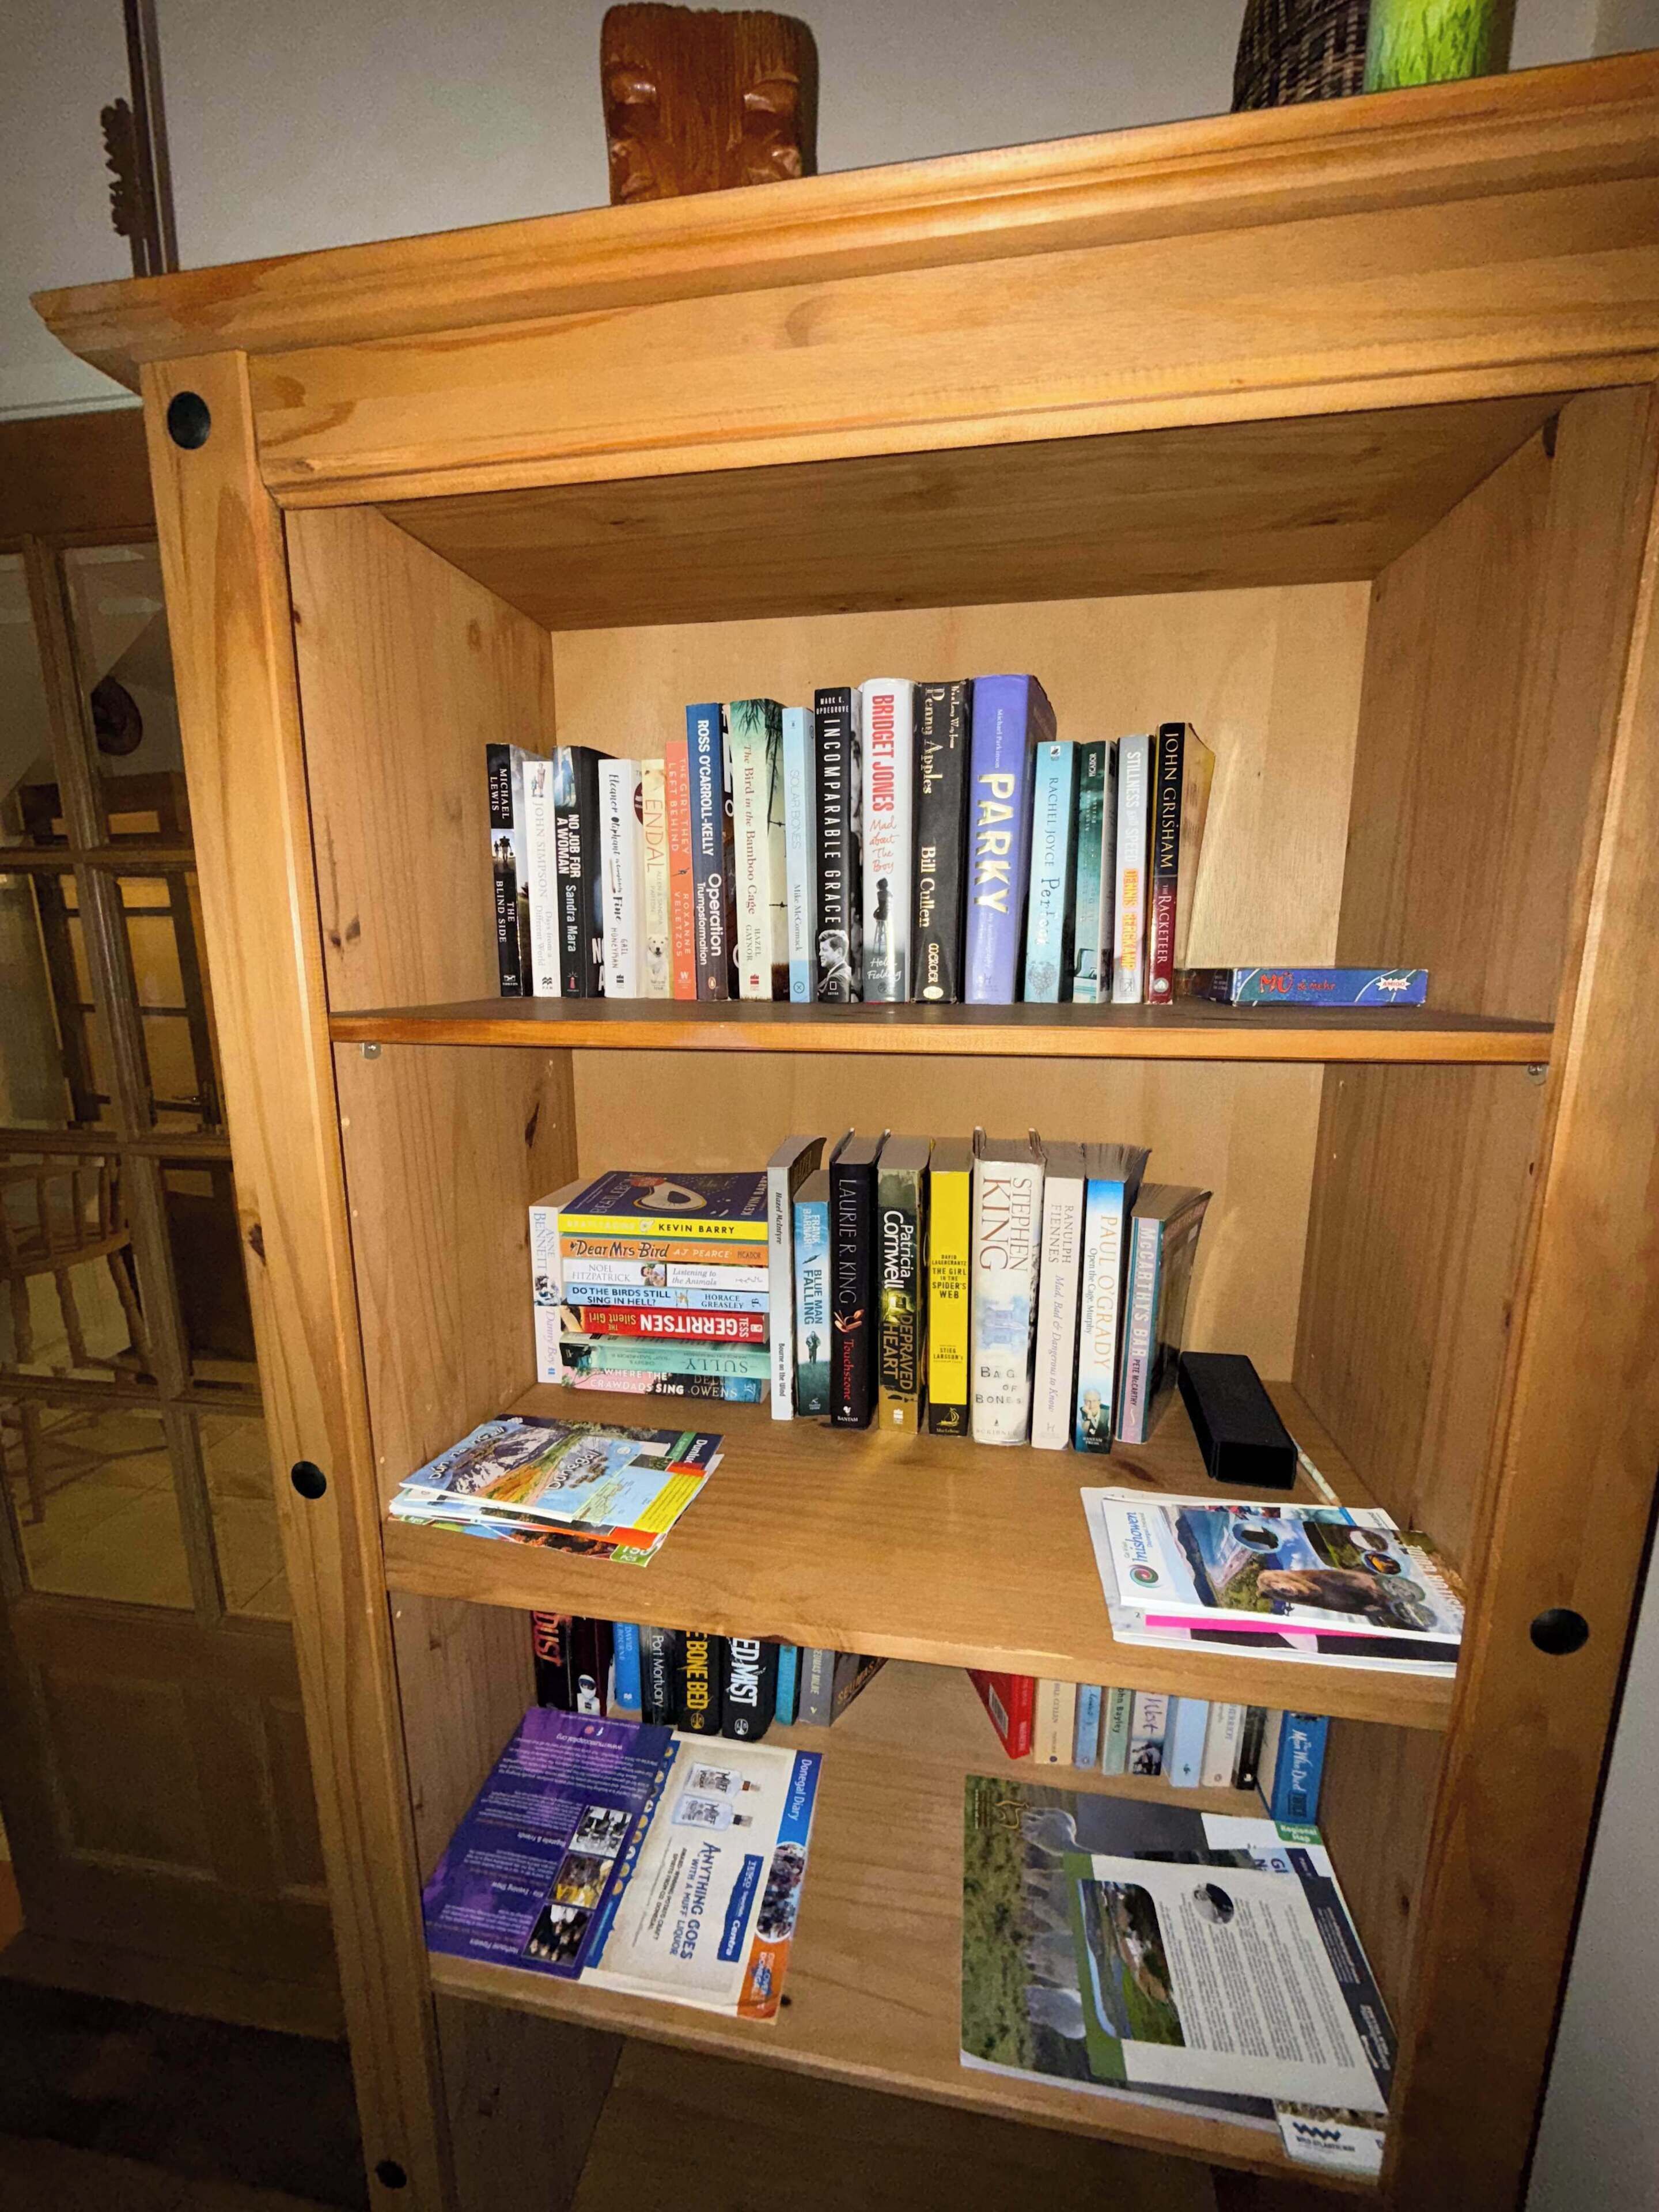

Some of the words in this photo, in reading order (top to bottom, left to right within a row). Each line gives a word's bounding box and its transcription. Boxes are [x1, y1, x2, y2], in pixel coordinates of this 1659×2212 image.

[816, 705, 849, 715] UPDEGROVE
[820, 697, 835, 705] MARK
[922, 687, 945, 736] Penny
[698, 720, 710, 753] ROSS
[872, 695, 894, 758] BRIDGET
[744, 745, 752, 763] The
[921, 738, 944, 794] Apples
[1088, 752, 1097, 777] PICADOR
[1165, 733, 1179, 781] JOHN
[490, 777, 499, 812] LEWIS
[499, 768, 510, 819] MICHAEL
[669, 762, 677, 794] LEFT
[744, 768, 755, 794] Bird
[790, 769, 800, 808] SOLAR
[824, 719, 841, 859] INCOMPARABLE
[872, 762, 895, 812] JONES
[699, 755, 714, 857] O'CARROLL-KELLY
[745, 811, 753, 827] the
[746, 798, 753, 806] in
[1047, 777, 1059, 825] RACHEL
[533, 801, 544, 839] JOHN
[557, 817, 568, 825] A
[569, 814, 579, 830] NO
[644, 800, 665, 873] ENDAL
[670, 801, 679, 851] BEHIND
[680, 819, 690, 854] THEY
[790, 810, 802, 850] BONES
[870, 817, 896, 831] Mad
[1160, 787, 1178, 868] GRISHAM
[558, 828, 570, 874] WOMAN
[569, 832, 580, 853] JOB
[746, 831, 757, 881] Bamboo
[869, 832, 899, 846] about
[873, 849, 893, 858] The
[974, 774, 1015, 914] PARKY
[1044, 830, 1056, 866] JOYCE
[536, 842, 547, 898] SIMPSON
[569, 856, 581, 878] FOR
[872, 860, 895, 874] Boy
[921, 847, 936, 873] Bill
[496, 881, 505, 914] BLIND
[566, 885, 577, 922] Sandra
[746, 885, 757, 915] Cage
[824, 870, 841, 923] GRACE
[919, 877, 935, 928] Cullen
[1122, 868, 1138, 908] DENNIS
[507, 902, 516, 922] THE
[674, 891, 683, 957] VELETZOS
[682, 893, 691, 955] ROXANNE
[696, 882, 708, 965] Trumpsformation
[706, 873, 723, 956] Operation
[794, 900, 803, 952] McCormack
[1157, 895, 1172, 964] RACKETEER
[498, 918, 507, 943] SIDE
[567, 926, 578, 952] Mara
[611, 927, 620, 968] HONEYMAN
[620, 938, 628, 955] GAIL
[1121, 912, 1137, 971] BERGKAMP
[839, 1179, 857, 1238] LAURIE
[979, 1177, 1012, 1271] KING
[1009, 1177, 1032, 1272] STEPHEN
[533, 1212, 547, 1270] BENNETT
[544, 1228, 555, 1259] ANNE
[774, 1213, 783, 1244] McIntyre
[1048, 1204, 1062, 1263] FIENNES
[1062, 1205, 1074, 1264] RANULPH
[1099, 1215, 1118, 1267] PAUL
[575, 1240, 608, 1256] Dear
[609, 1241, 635, 1256] Mrs
[638, 1242, 670, 1258] Bird
[692, 1249, 730, 1259] PEARCE
[737, 1251, 762, 1259] PICADOR
[839, 1244, 857, 1256] R.
[884, 1210, 904, 1289] Cornwell
[900, 1225, 914, 1278] Patricia
[572, 1271, 631, 1282] FITZPATRICK
[589, 1264, 613, 1272] NOEL
[673, 1268, 708, 1278] Listening
[814, 1270, 822, 1296] BLUE
[839, 1262, 857, 1304] KING
[932, 1282, 967, 1290] SPIDER'S
[612, 1288, 641, 1297] BIRDS
[643, 1290, 671, 1298] STILL
[627, 1298, 656, 1306] HELL?
[804, 1270, 815, 1325] FALLING
[940, 1290, 959, 1298] WEB
[543, 1310, 555, 1344] Danny
[589, 1312, 605, 1323] Girl
[609, 1313, 637, 1325] Silent
[640, 1314, 738, 1336] GERRITSEN
[739, 1317, 749, 1338] TESS
[815, 1300, 823, 1324] MAN
[1093, 1275, 1115, 1370] O'GRADY
[547, 1346, 558, 1365] Boy
[685, 1358, 748, 1373] SULLY
[883, 1323, 899, 1380] HEART
[900, 1315, 913, 1391] DEPRAVED
[1132, 1358, 1141, 1374] PETE
[590, 1379, 653, 1392] CRAWDADS
[655, 1384, 684, 1395] SING
[843, 1339, 854, 1401] Touchstone
[1130, 1374, 1140, 1406] McCARTHY
[1126, 1512, 1148, 1562] Inishowen
[652, 1635, 664, 1656] Port
[686, 1641, 708, 1679] BONE
[653, 1659, 666, 1708] Mortuary
[686, 1681, 709, 1709] BED
[794, 1759, 813, 1795] Donegal
[787, 1796, 805, 1821] Diary
[687, 1858, 699, 1881] WITH
[691, 1841, 722, 1916] ANYTHING
[679, 1892, 691, 1918] MUFF
[669, 1919, 685, 1955] LIQUOR
[680, 1919, 700, 1959] GOES
[725, 1920, 741, 1956] Centra
